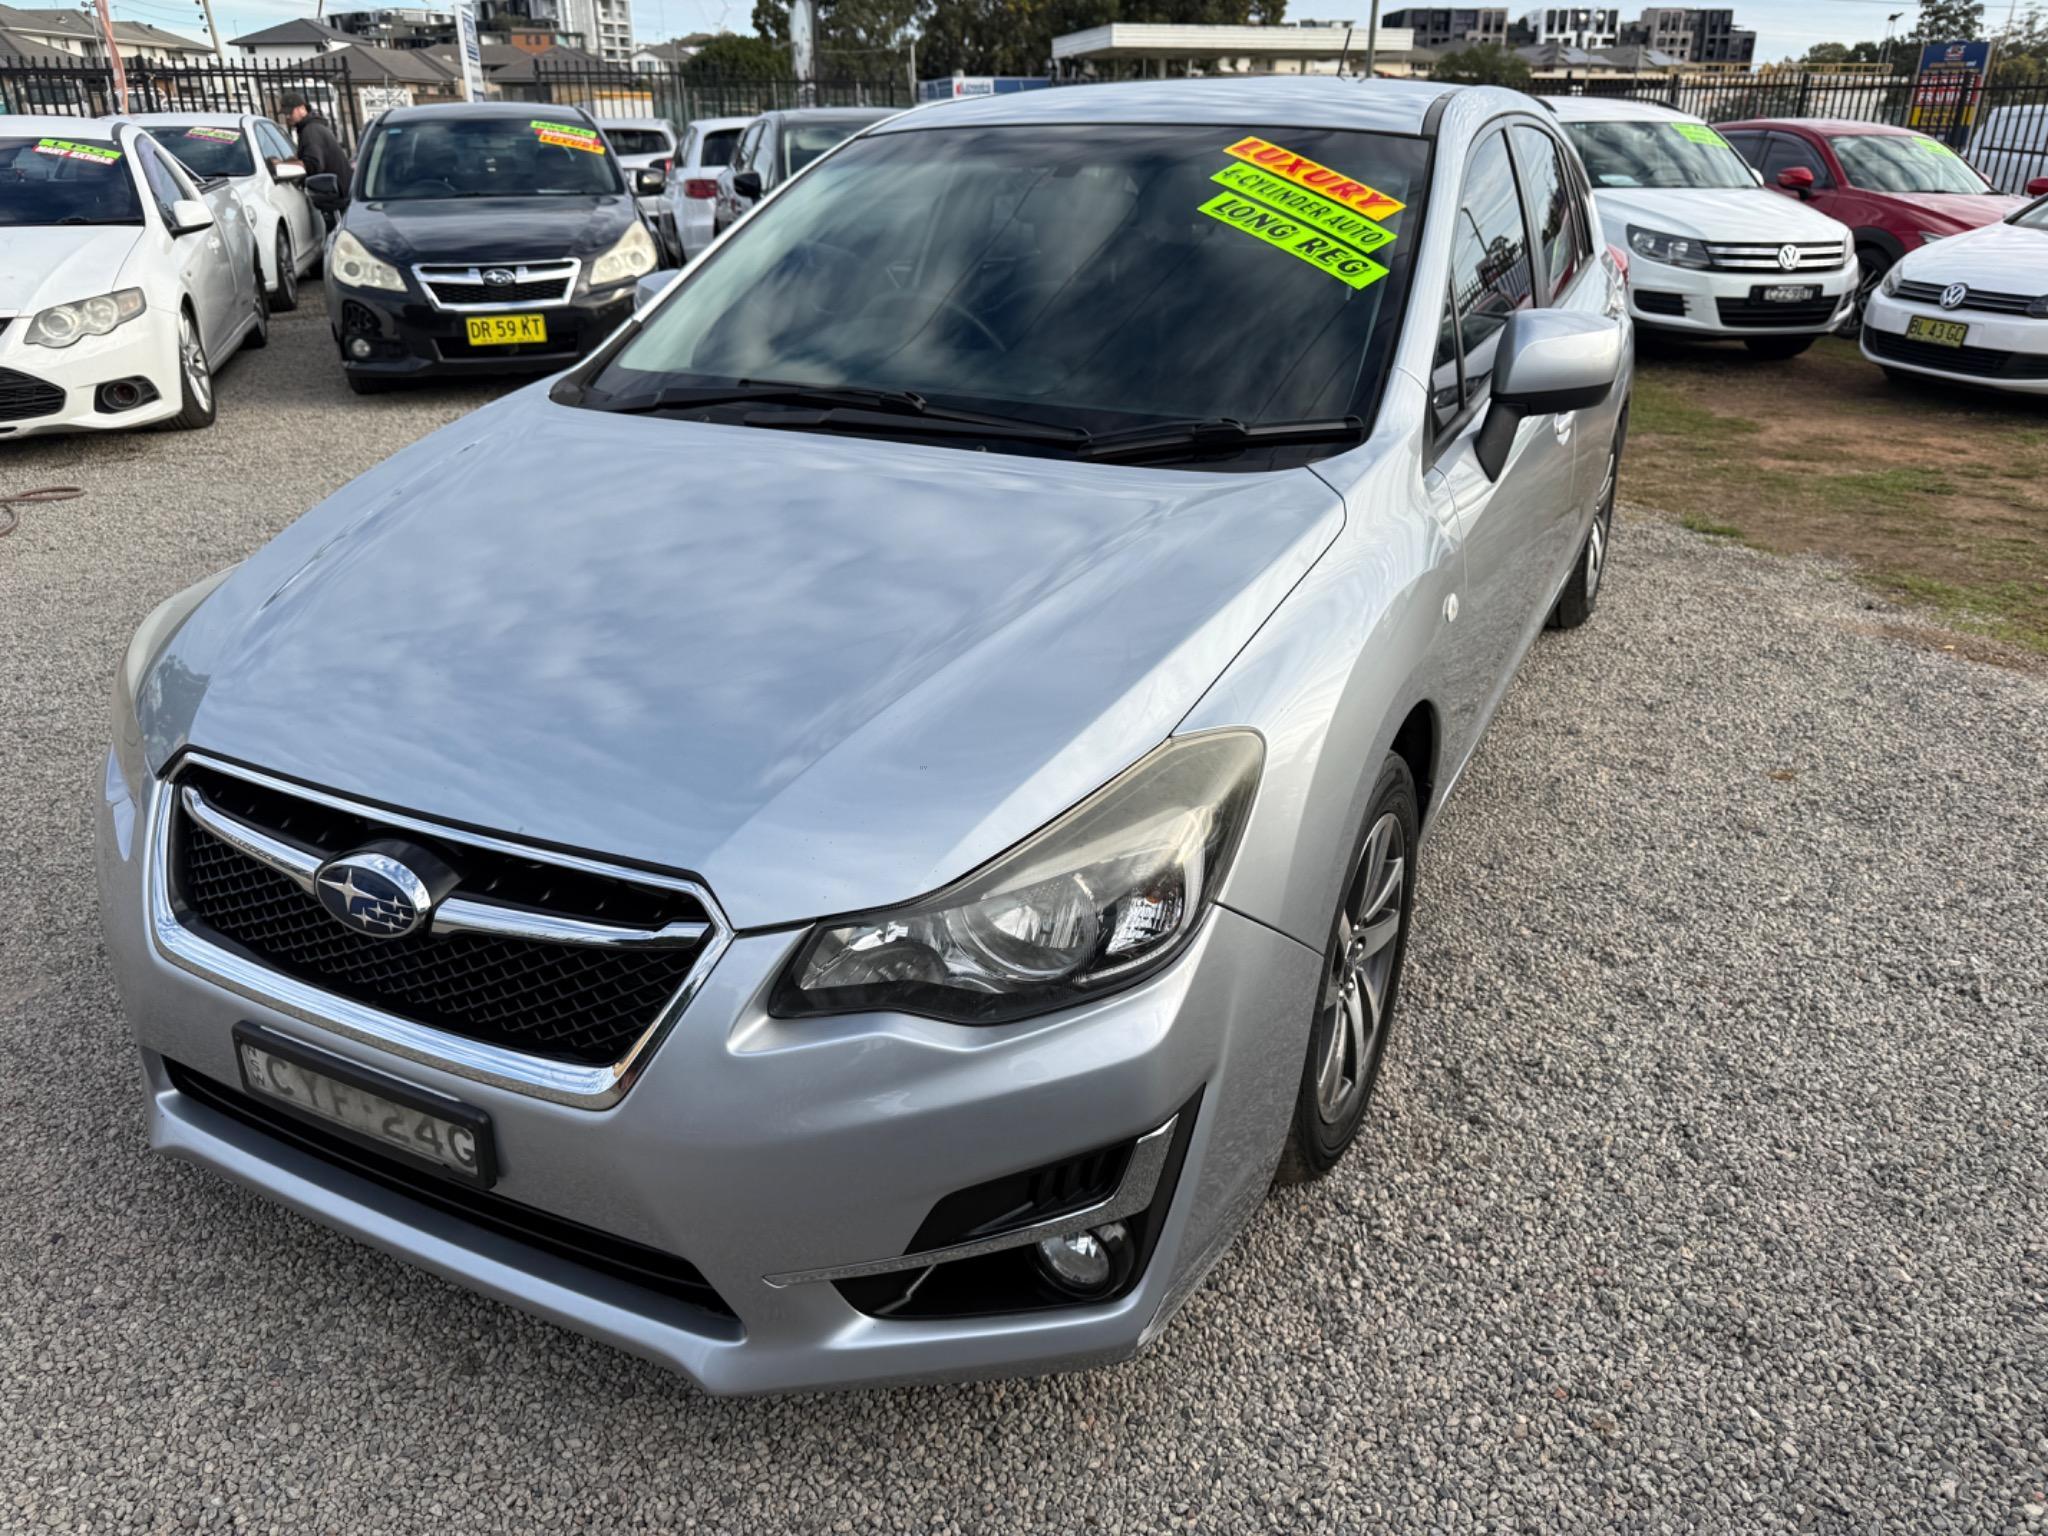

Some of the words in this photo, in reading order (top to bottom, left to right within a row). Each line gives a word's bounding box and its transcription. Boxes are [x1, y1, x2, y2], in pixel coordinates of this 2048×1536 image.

[1222, 168, 1331, 217] 4-CYLINDER
[1325, 214, 1386, 245] AUTO
[1231, 139, 1398, 209] LUXURY
[1211, 199, 1299, 239] LONG
[1294, 237, 1371, 277] REG
[470, 321, 491, 339] DR
[496, 320, 516, 337] 59
[521, 317, 540, 336] KT
